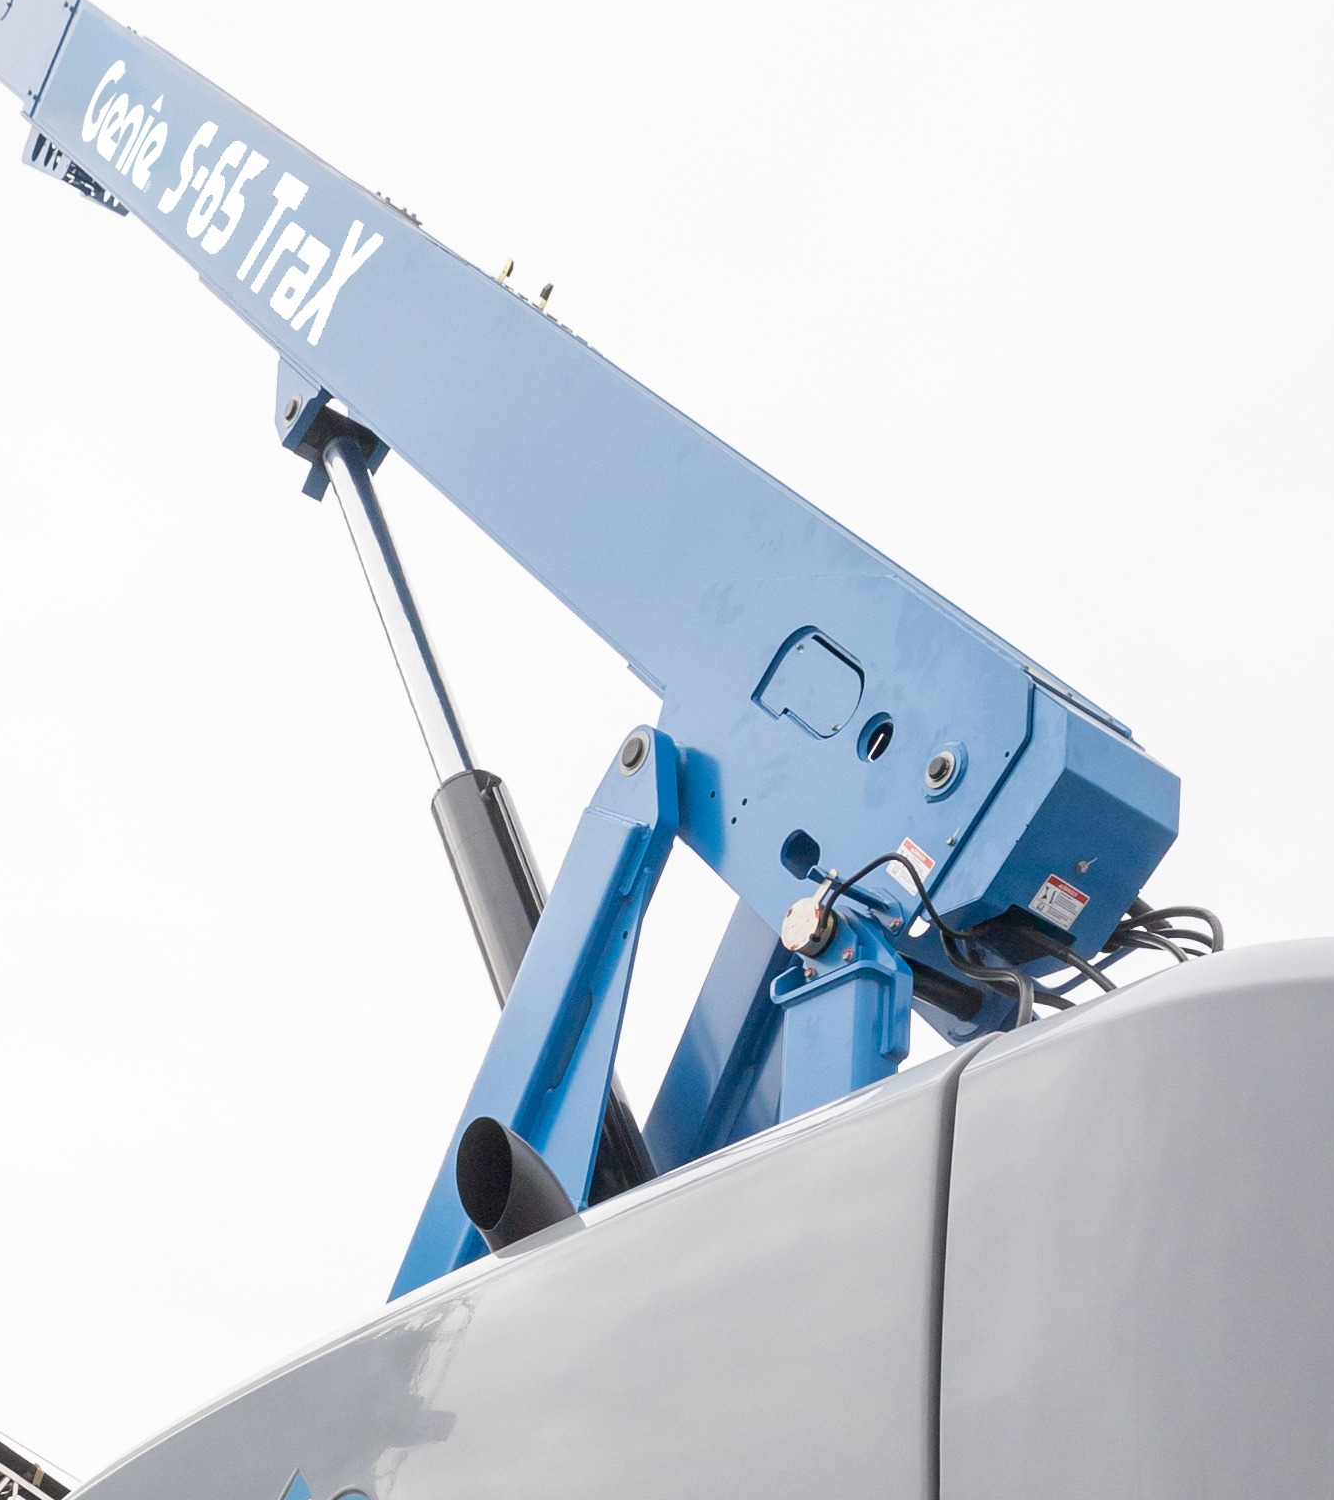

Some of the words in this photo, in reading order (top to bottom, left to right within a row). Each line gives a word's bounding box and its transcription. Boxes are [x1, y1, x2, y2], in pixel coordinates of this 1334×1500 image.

[82, 60, 168, 190] Genie
[158, 120, 269, 255] S-65
[237, 172, 384, 346] TraX
